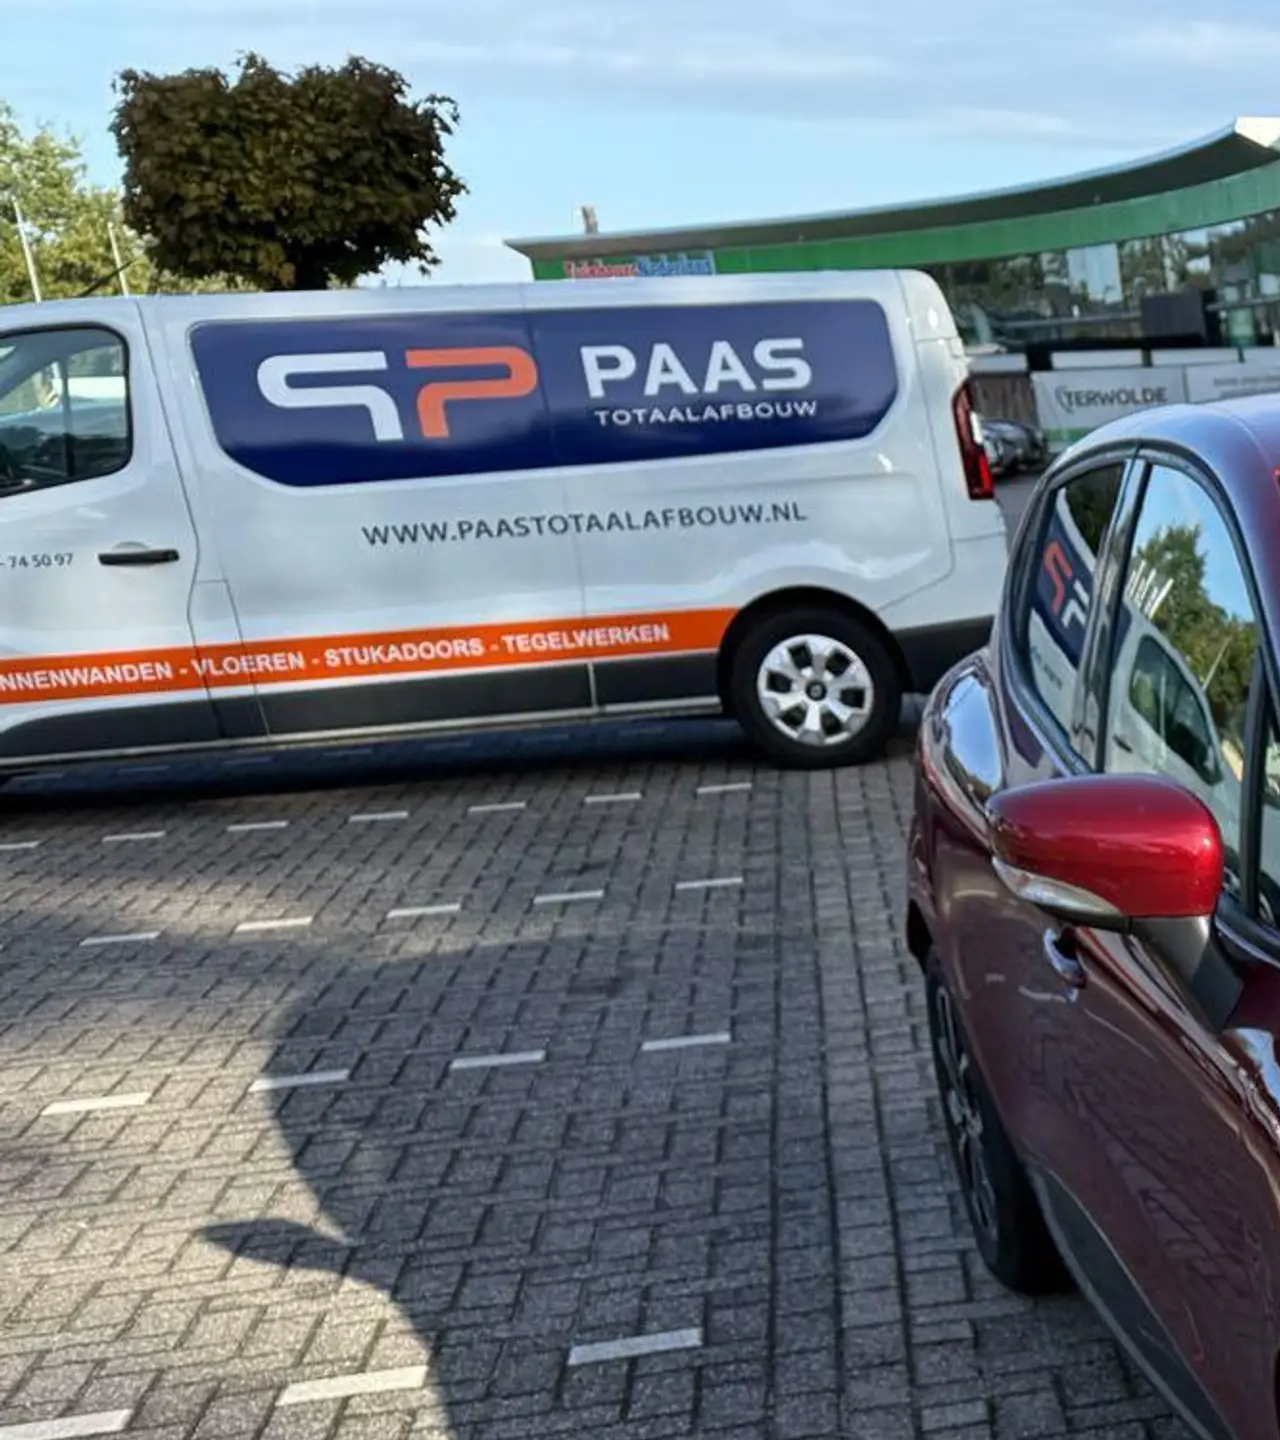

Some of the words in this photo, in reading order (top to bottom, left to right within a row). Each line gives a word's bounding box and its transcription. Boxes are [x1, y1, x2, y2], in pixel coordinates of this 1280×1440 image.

[580, 337, 812, 398] PAAS
[594, 400, 818, 427] TOTAALAFBOUW
[361, 502, 808, 547] WWW.PAASTOTAALAFBOUW.NL
[191, 652, 305, 677] VLOEREN
[325, 638, 485, 667] STUKADOORS
[503, 623, 671, 655] TEGELWERKEN
